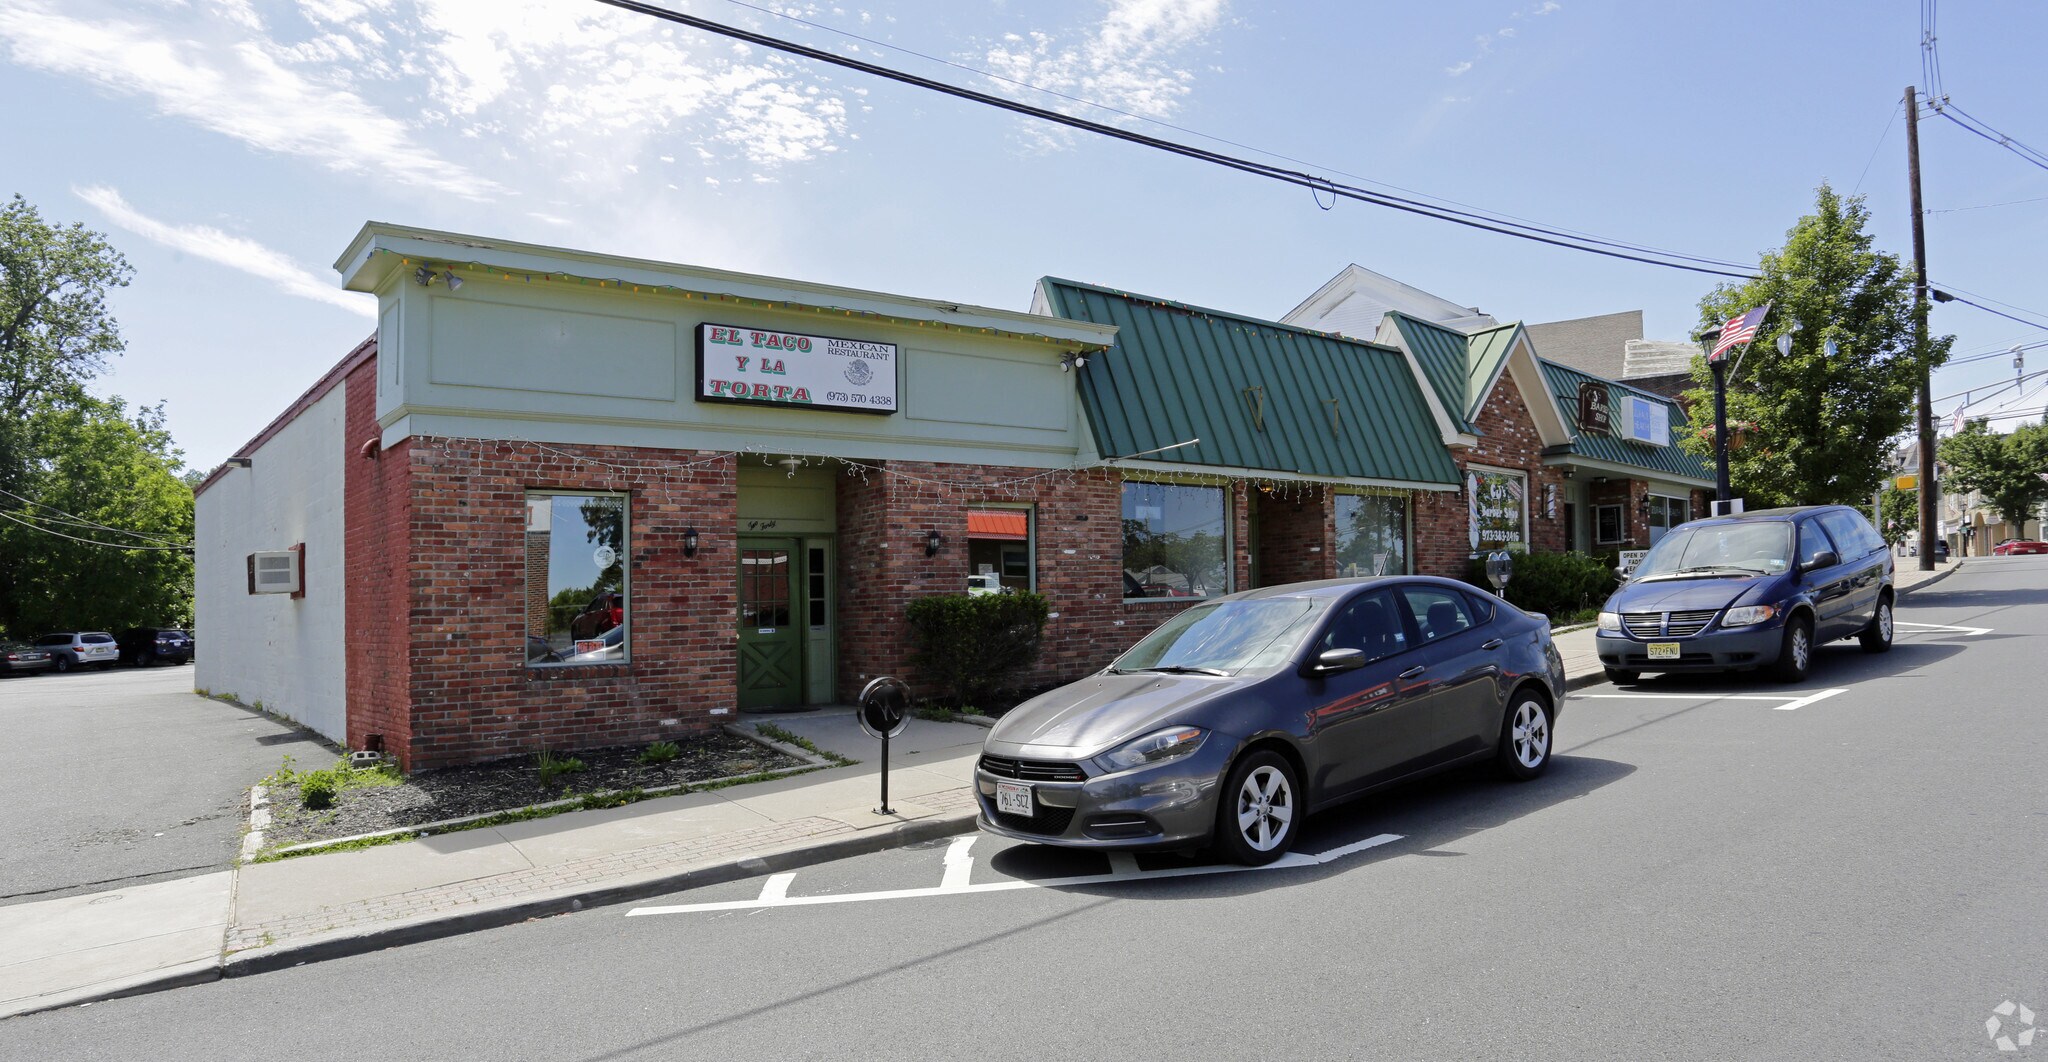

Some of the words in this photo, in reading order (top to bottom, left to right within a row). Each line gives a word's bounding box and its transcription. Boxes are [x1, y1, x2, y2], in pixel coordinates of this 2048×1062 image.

[709, 327, 743, 346] EL
[750, 330, 813, 353] TACO
[828, 339, 889, 353] MEXICAN
[827, 347, 890, 361] RESTAURANT
[736, 356, 749, 372] Y
[760, 358, 786, 375] LA
[709, 379, 813, 403] TORTA
[826, 391, 848, 403] (973)
[850, 393, 867, 403] 570
[869, 395, 892, 406] 4338
